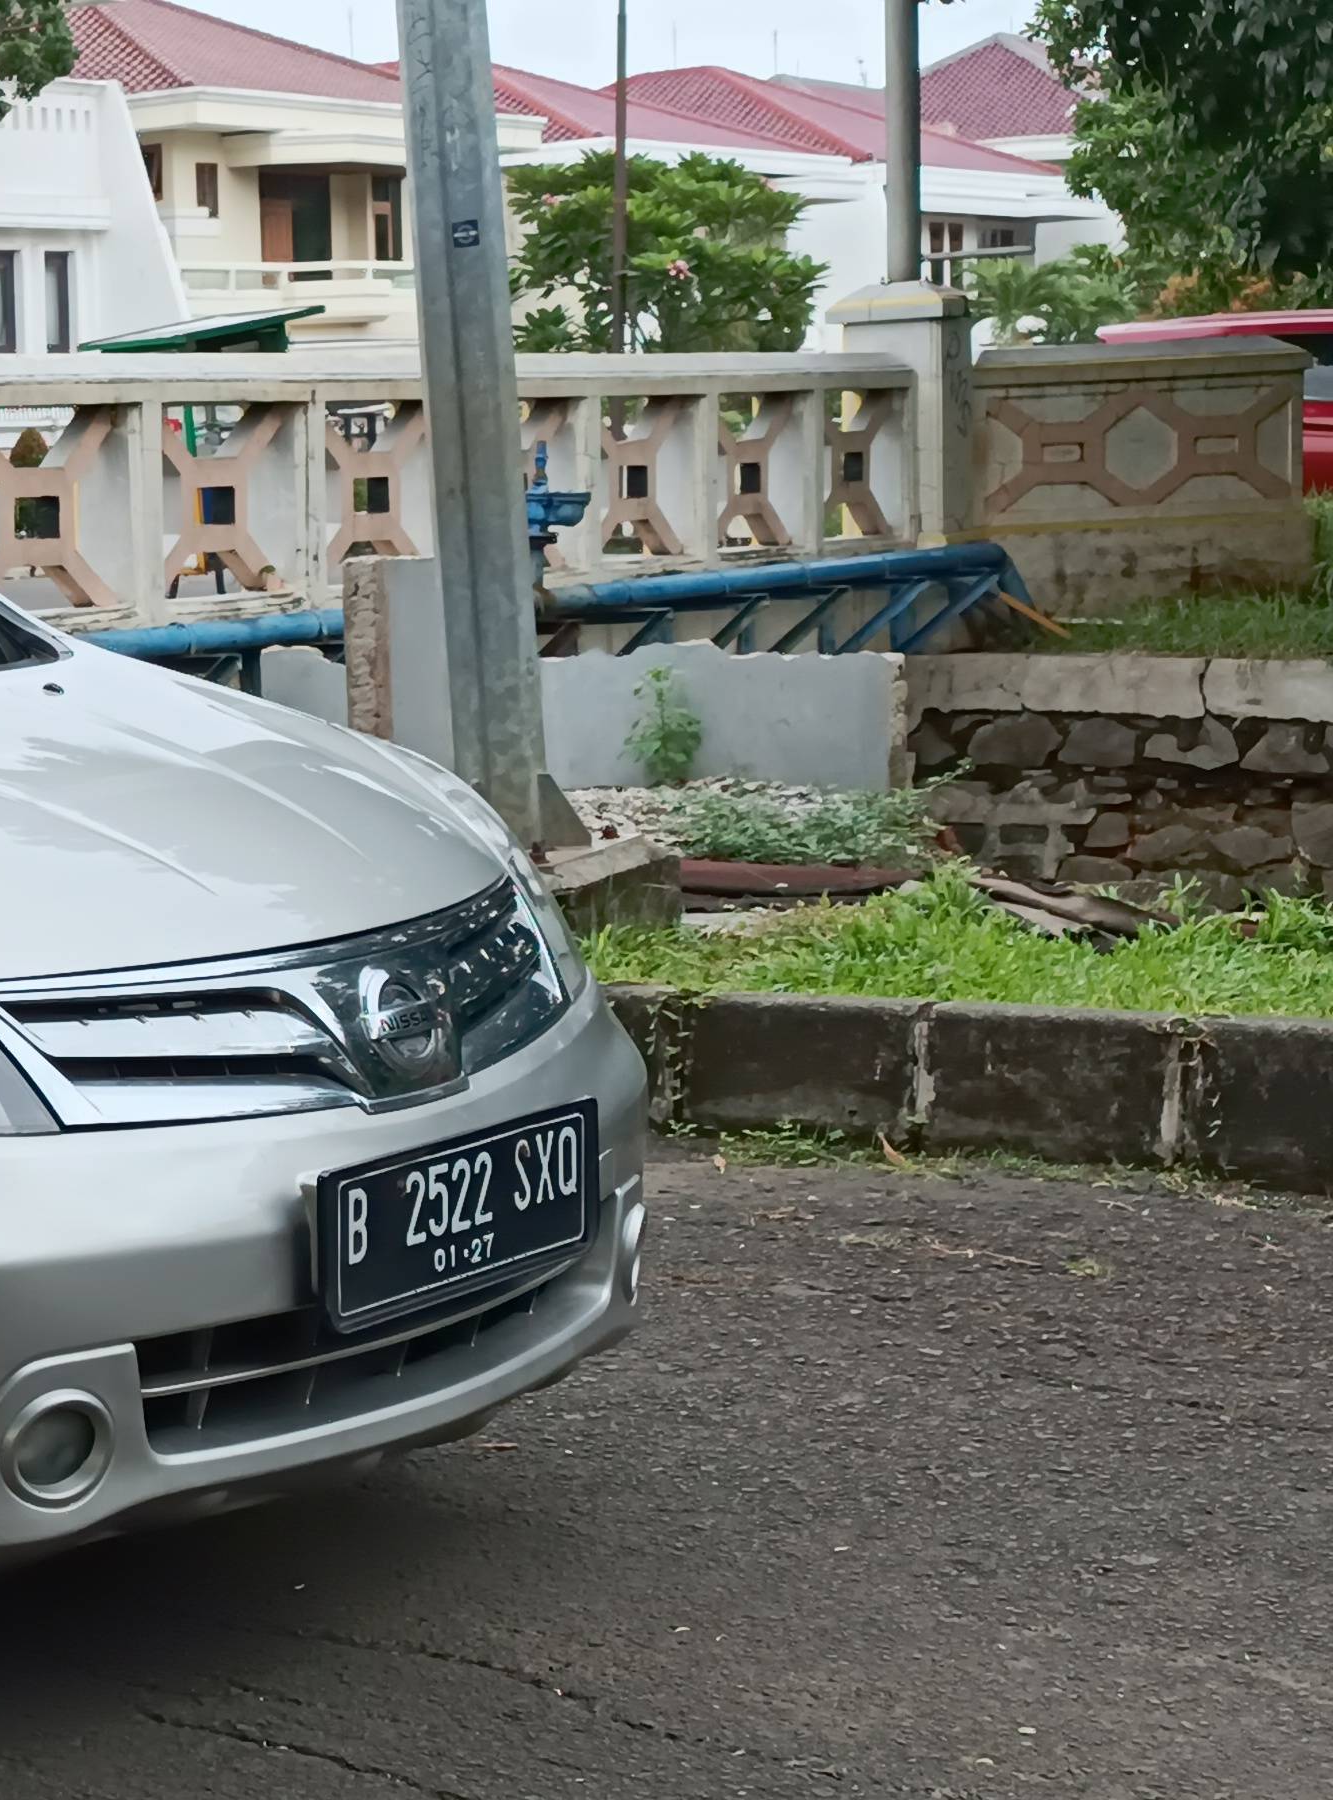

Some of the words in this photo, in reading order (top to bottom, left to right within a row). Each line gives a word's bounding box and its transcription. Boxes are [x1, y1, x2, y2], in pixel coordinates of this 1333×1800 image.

[380, 1009, 432, 1032] NISSA
[348, 1187, 368, 1265] B
[405, 1151, 493, 1247] 2522
[514, 1126, 577, 1211] SXQ
